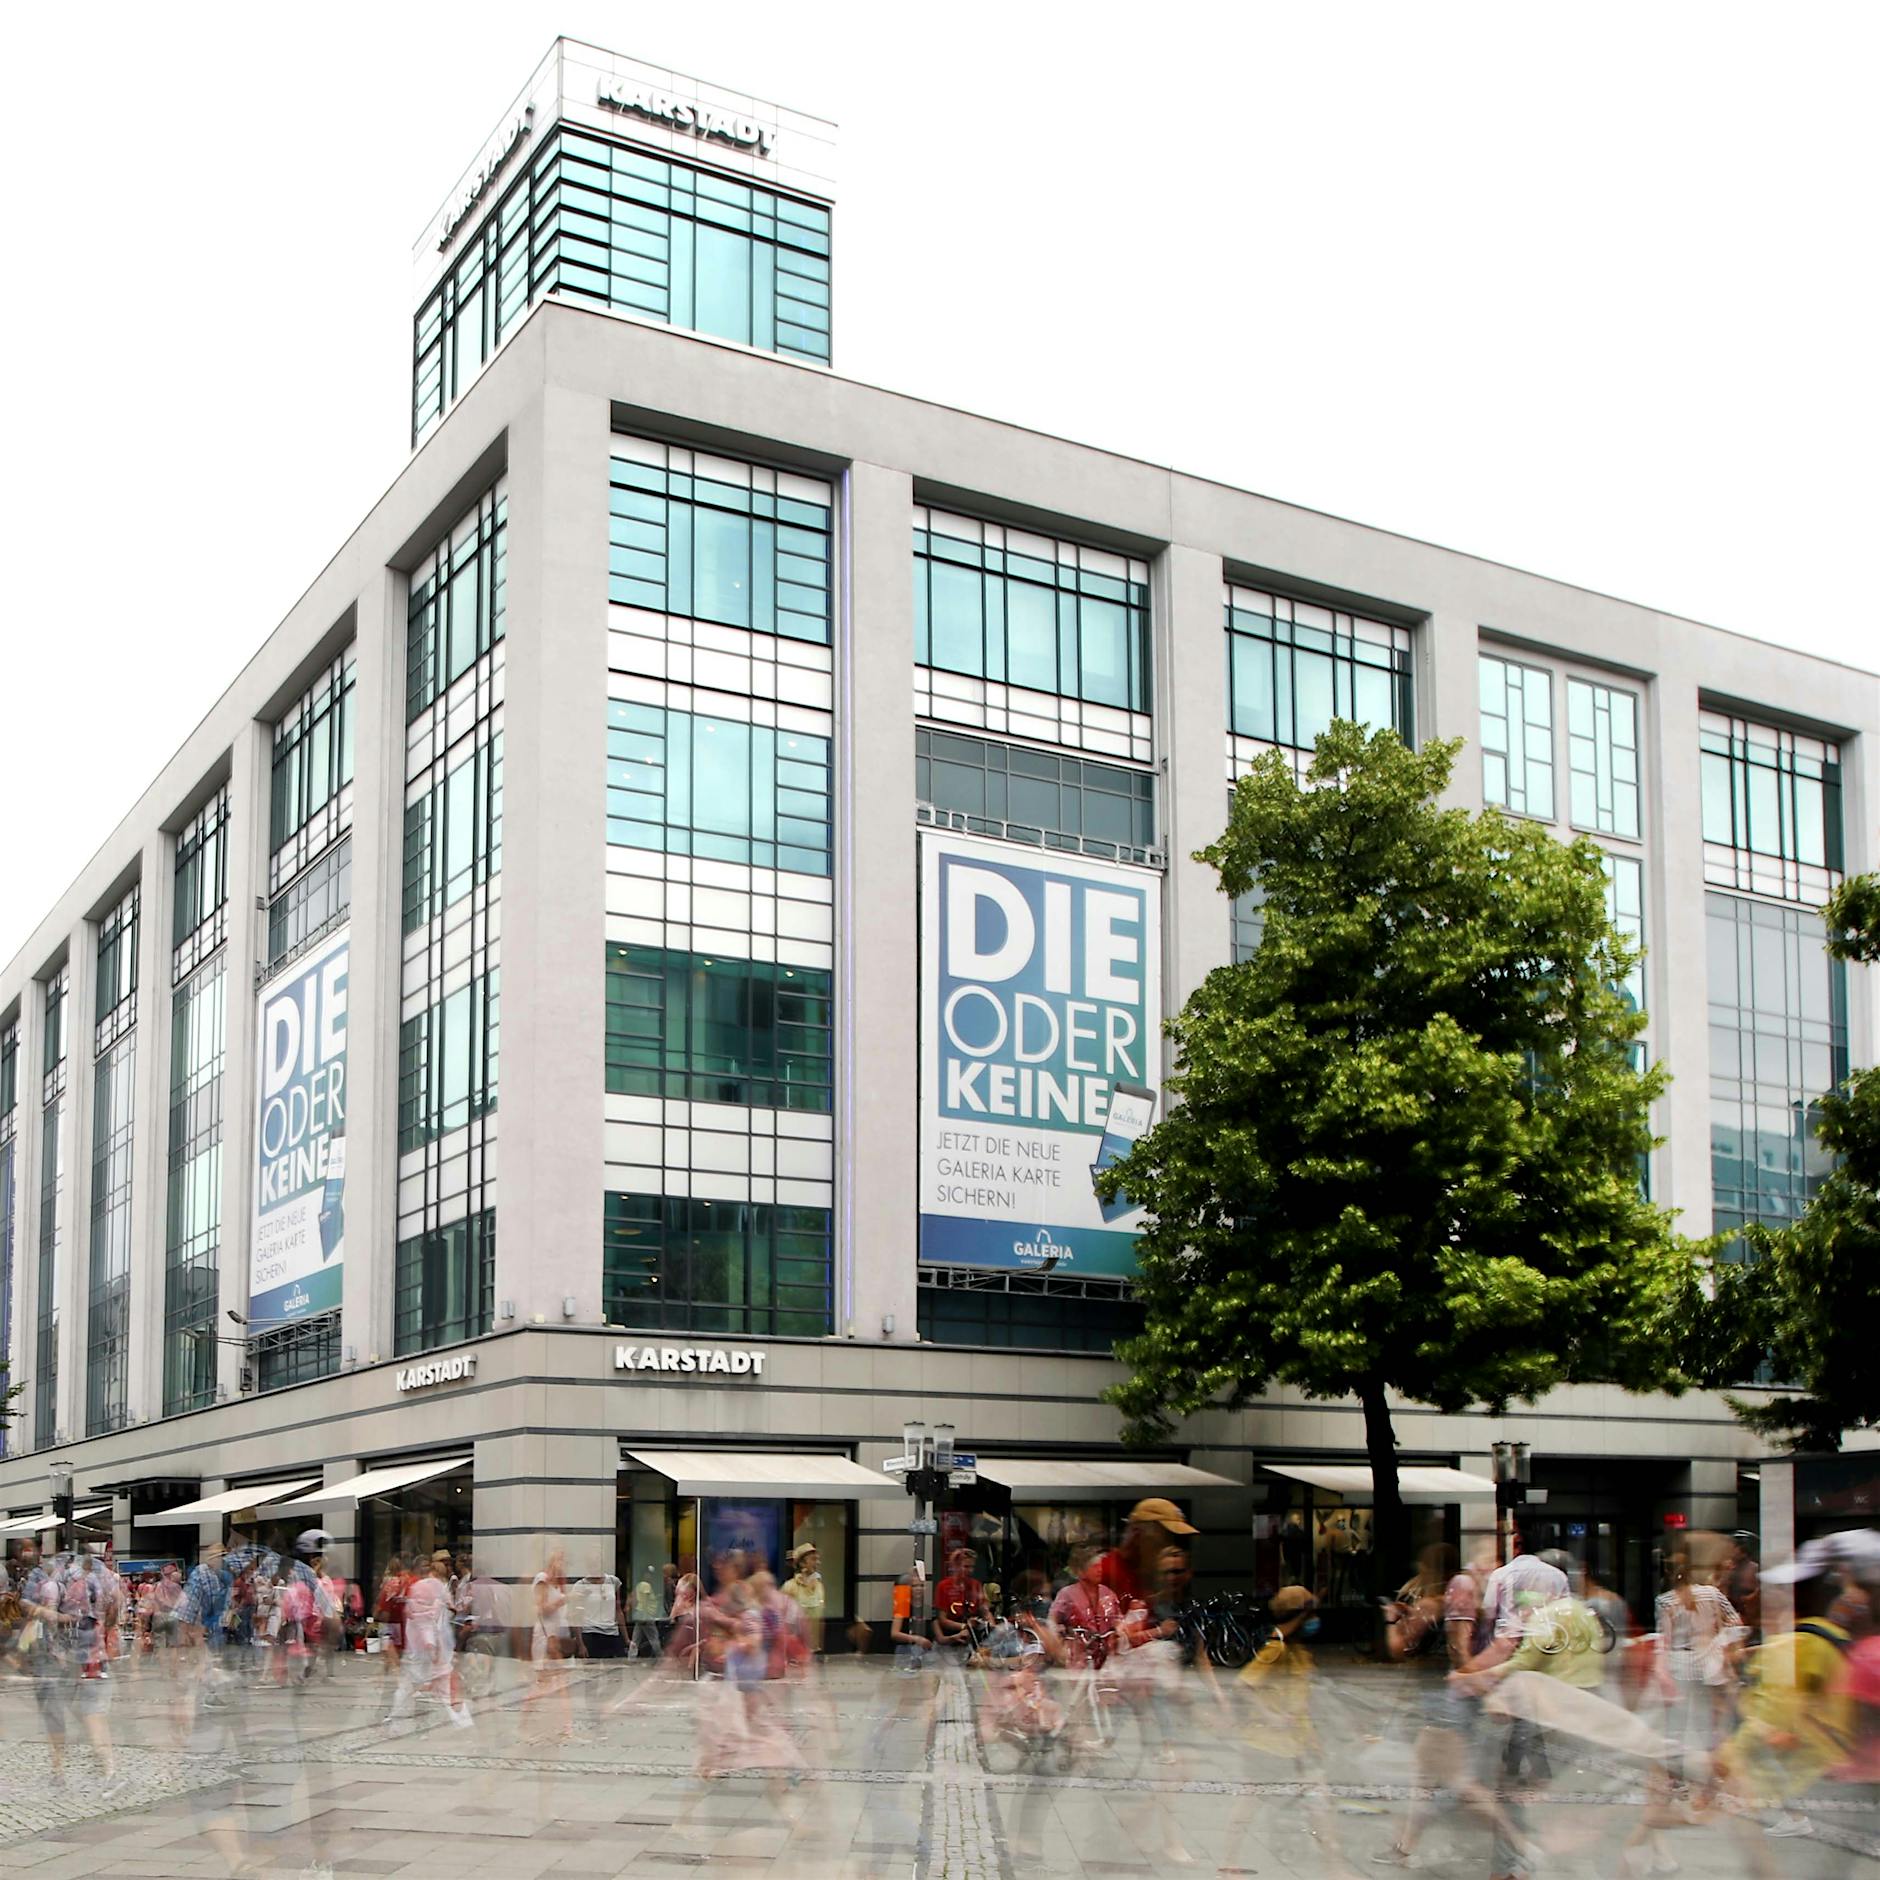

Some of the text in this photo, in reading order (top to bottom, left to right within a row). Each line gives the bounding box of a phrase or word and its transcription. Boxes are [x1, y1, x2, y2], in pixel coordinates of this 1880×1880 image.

[597, 75, 777, 156] KARSTADT
[437, 100, 536, 253] KARSTADT
[947, 863, 1140, 1005] DIE
[265, 949, 349, 1100] DIE
[943, 984, 1140, 1079] ODER
[262, 1060, 345, 1159] ODER
[947, 1057, 1110, 1127] KEINE
[261, 1131, 329, 1207] KEINE
[937, 1131, 1061, 1162] JETZT DIE NEUE
[937, 1158, 1061, 1187] GALERIA KARTE
[937, 1184, 1016, 1209] SICHERN!
[1013, 1241, 1074, 1260] GALERIA
[283, 1294, 310, 1312] GALERIA
[396, 1354, 477, 1393] KARSTADT
[615, 1345, 766, 1375] KARSTADT
